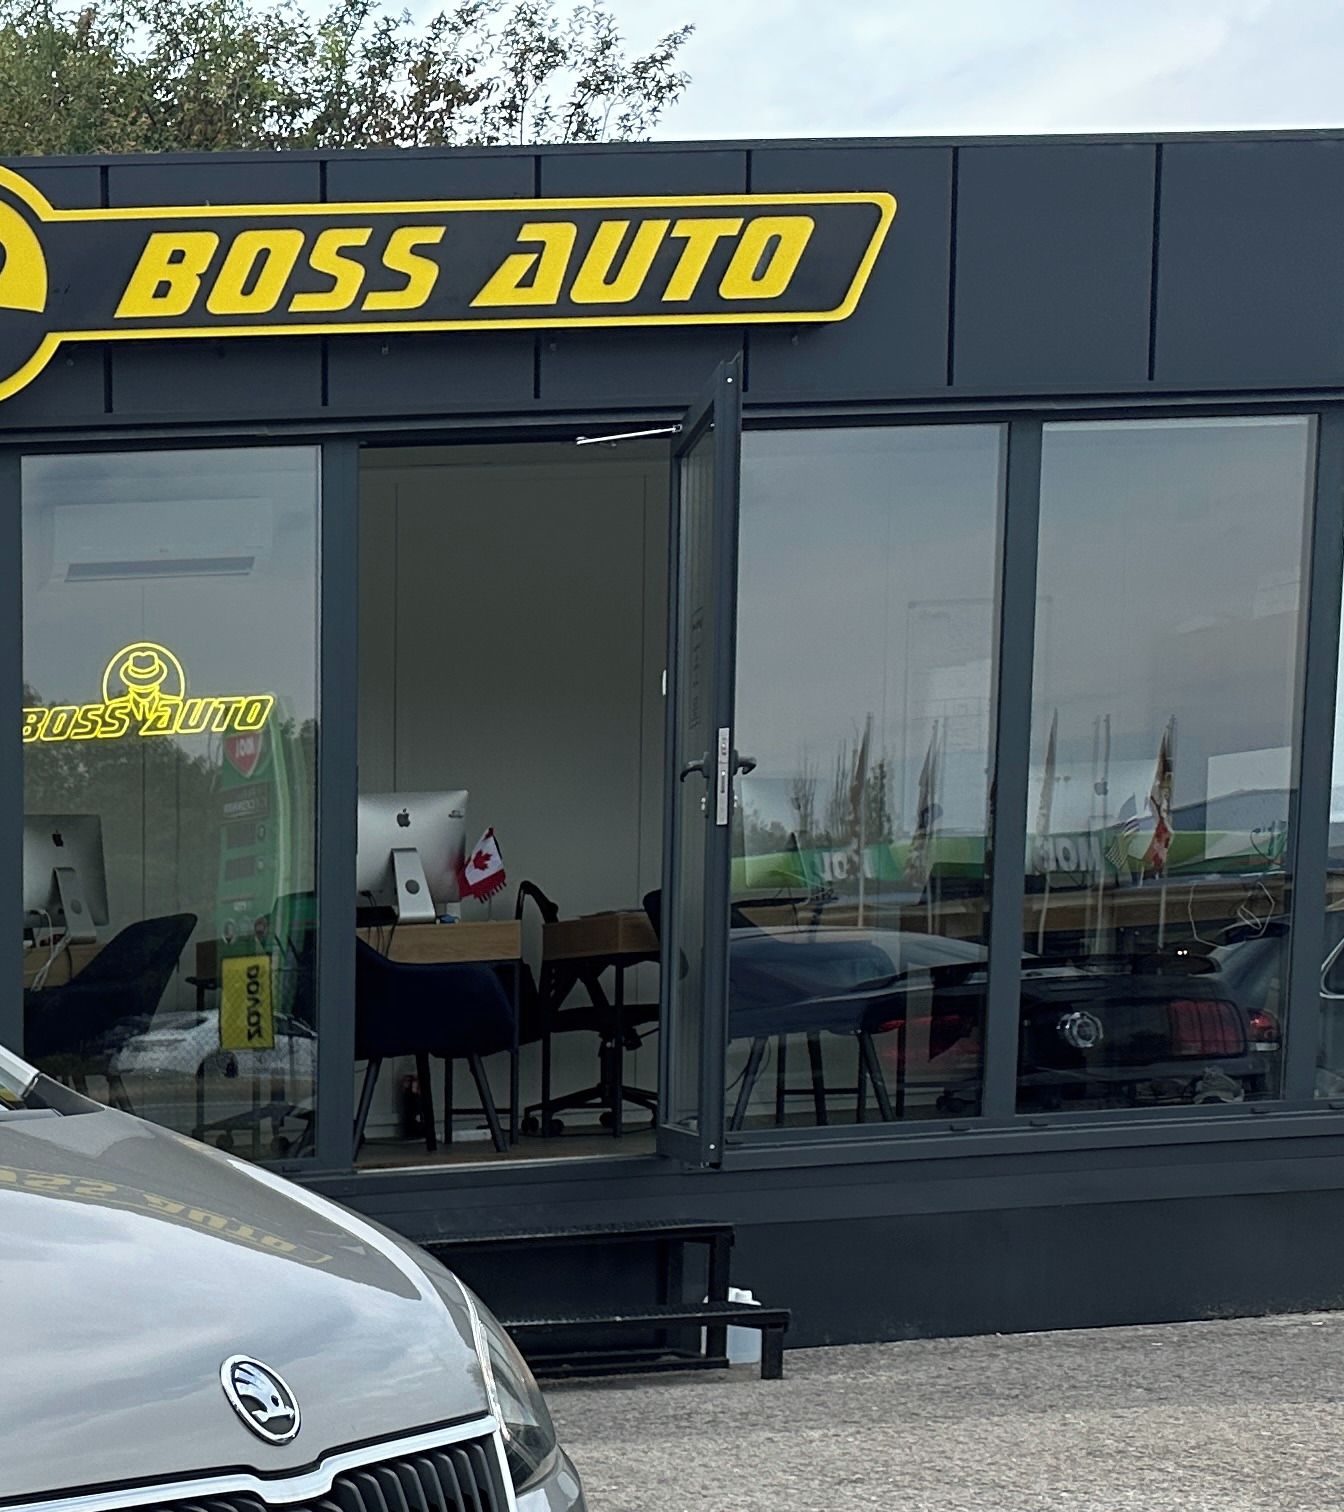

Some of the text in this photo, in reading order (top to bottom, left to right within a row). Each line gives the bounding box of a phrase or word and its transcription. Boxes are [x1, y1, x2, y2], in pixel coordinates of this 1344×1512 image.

[113, 216, 816, 319] BOSS AUTO
[23, 695, 274, 742] BOSS AUTO
